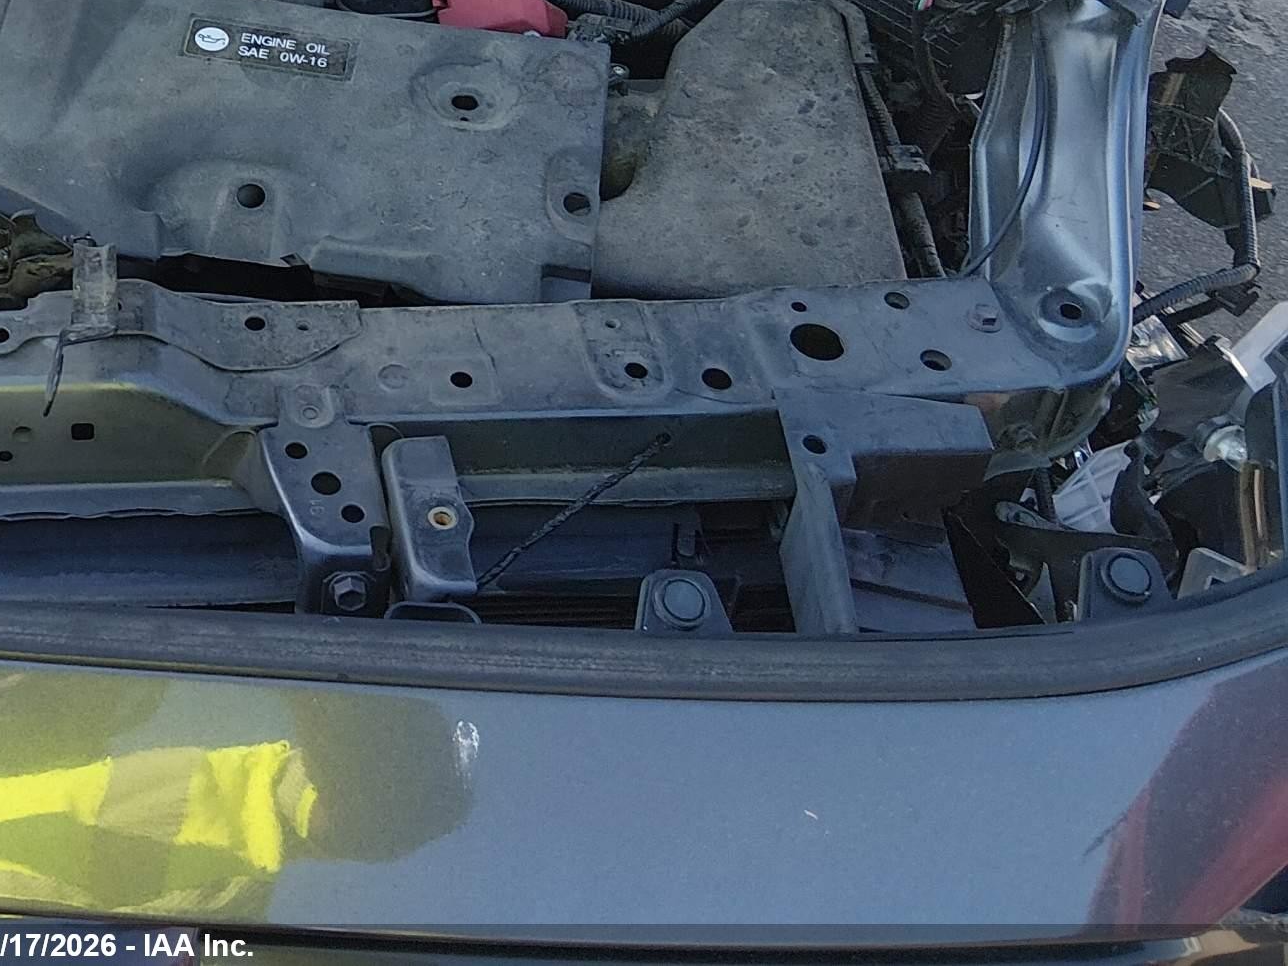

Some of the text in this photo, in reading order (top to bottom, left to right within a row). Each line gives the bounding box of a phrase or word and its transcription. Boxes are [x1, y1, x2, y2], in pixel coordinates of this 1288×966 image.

[241, 32, 330, 55] ENGINE OIL
[238, 45, 328, 68] SAE 0W-16
